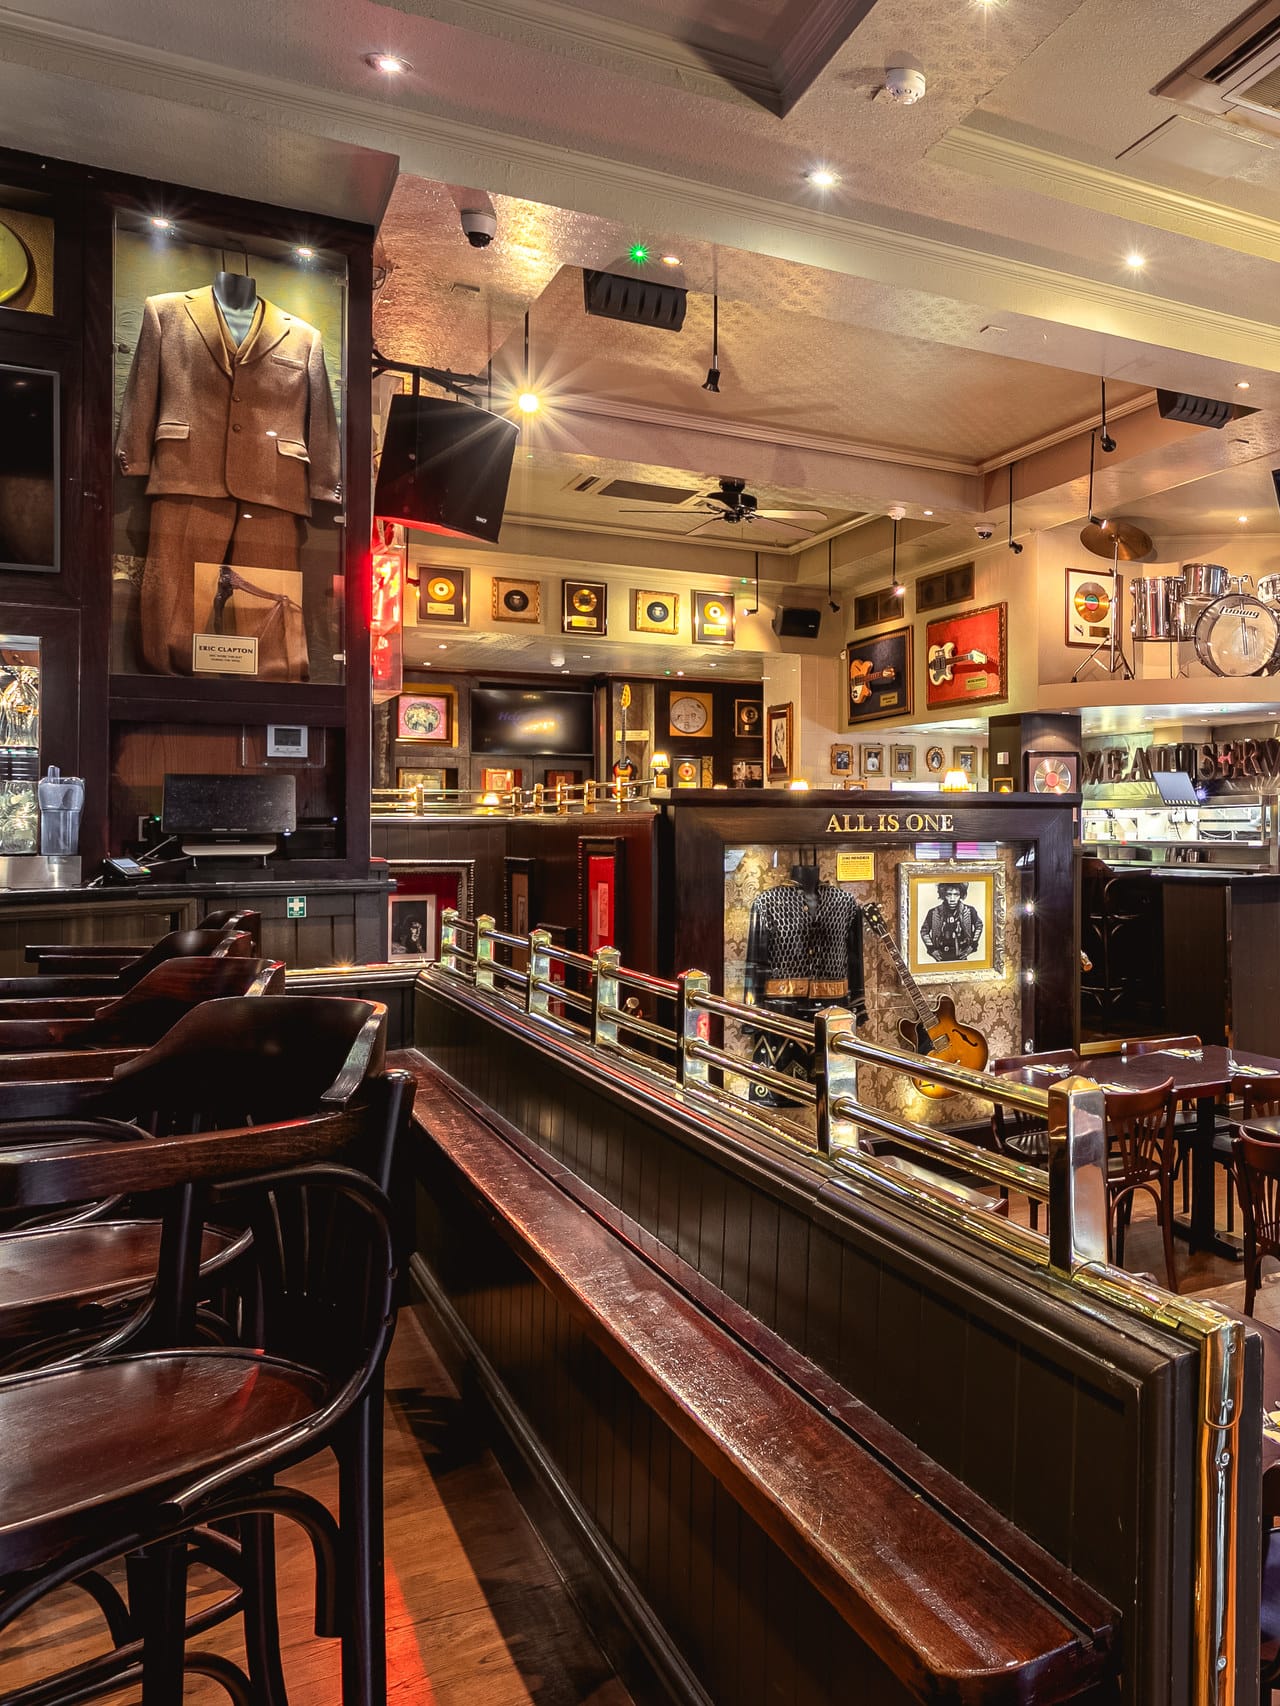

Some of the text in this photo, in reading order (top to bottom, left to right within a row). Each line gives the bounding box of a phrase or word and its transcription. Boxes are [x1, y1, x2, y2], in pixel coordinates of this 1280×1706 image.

[217, 646, 254, 655] CLAPTON
[825, 813, 954, 833] ALL IS ONE
